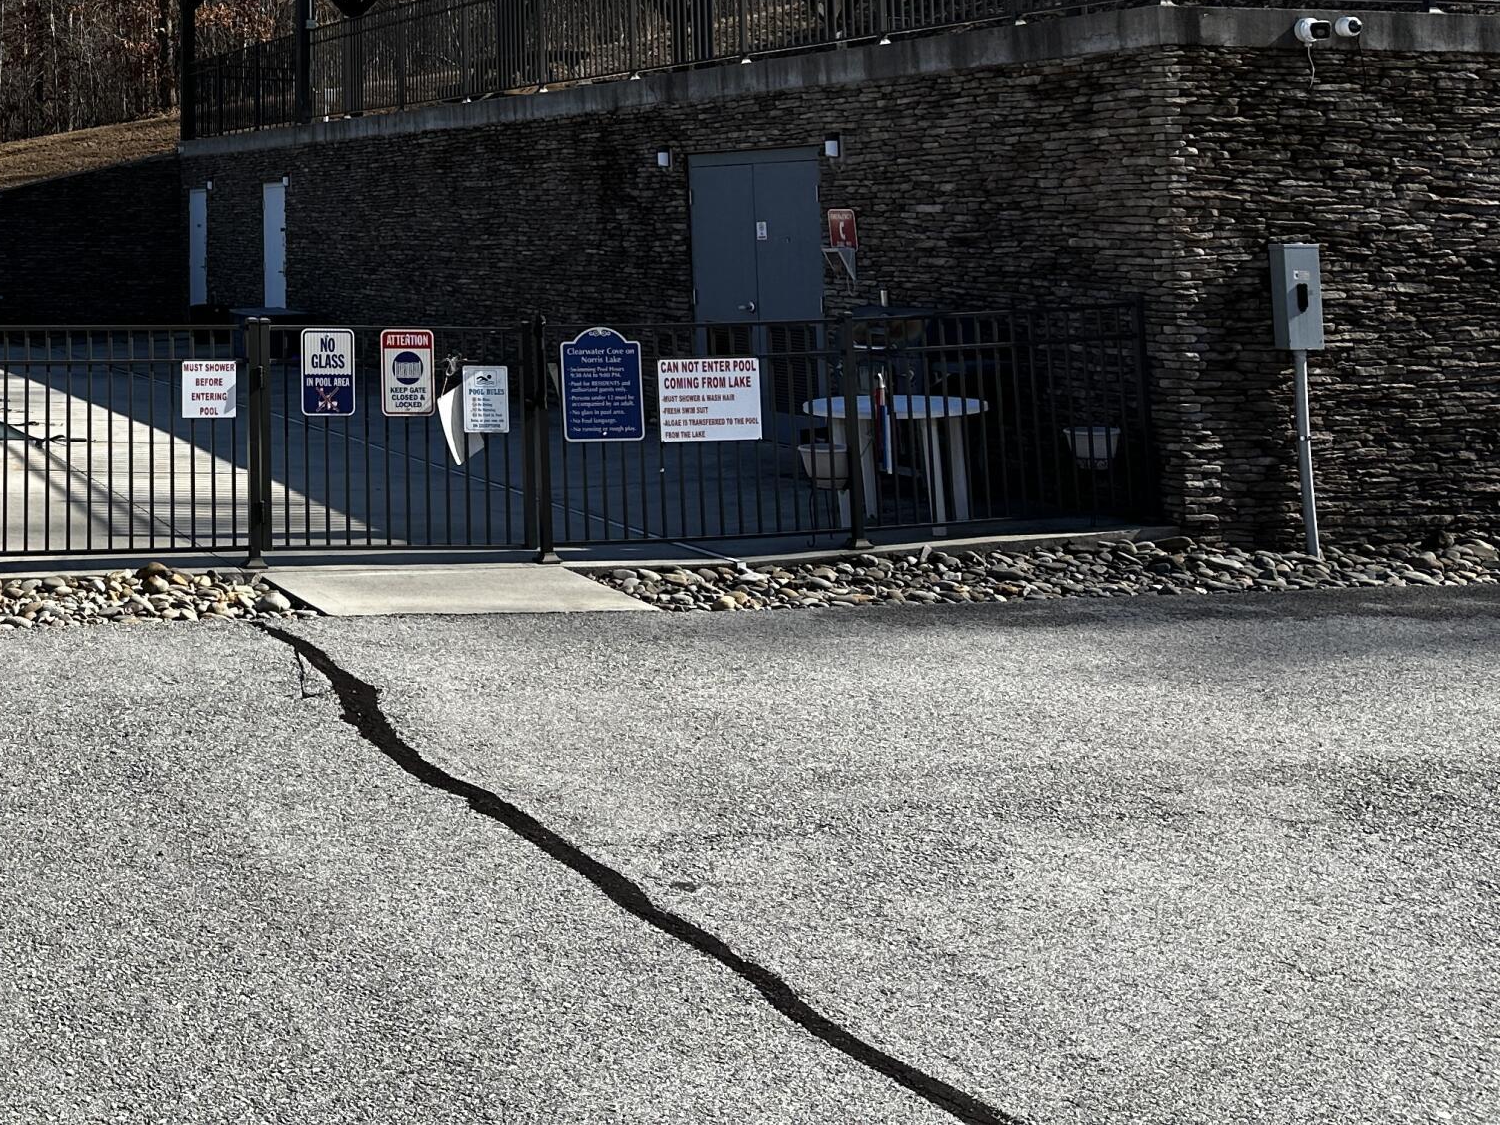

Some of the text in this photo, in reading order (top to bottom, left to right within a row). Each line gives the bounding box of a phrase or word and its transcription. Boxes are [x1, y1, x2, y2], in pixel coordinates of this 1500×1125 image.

[320, 338, 335, 352] NO
[386, 334, 428, 346] ATTENTION
[312, 354, 345, 368] GLASS
[660, 360, 756, 373] CAN NOT ENTER POOL
[184, 364, 234, 372] MUST SHOWER
[196, 378, 223, 386] BEFORE
[306, 378, 350, 386] IN POOL AREA
[664, 376, 751, 389] COMING FROM LAKE
[192, 392, 228, 400] ENTERING
